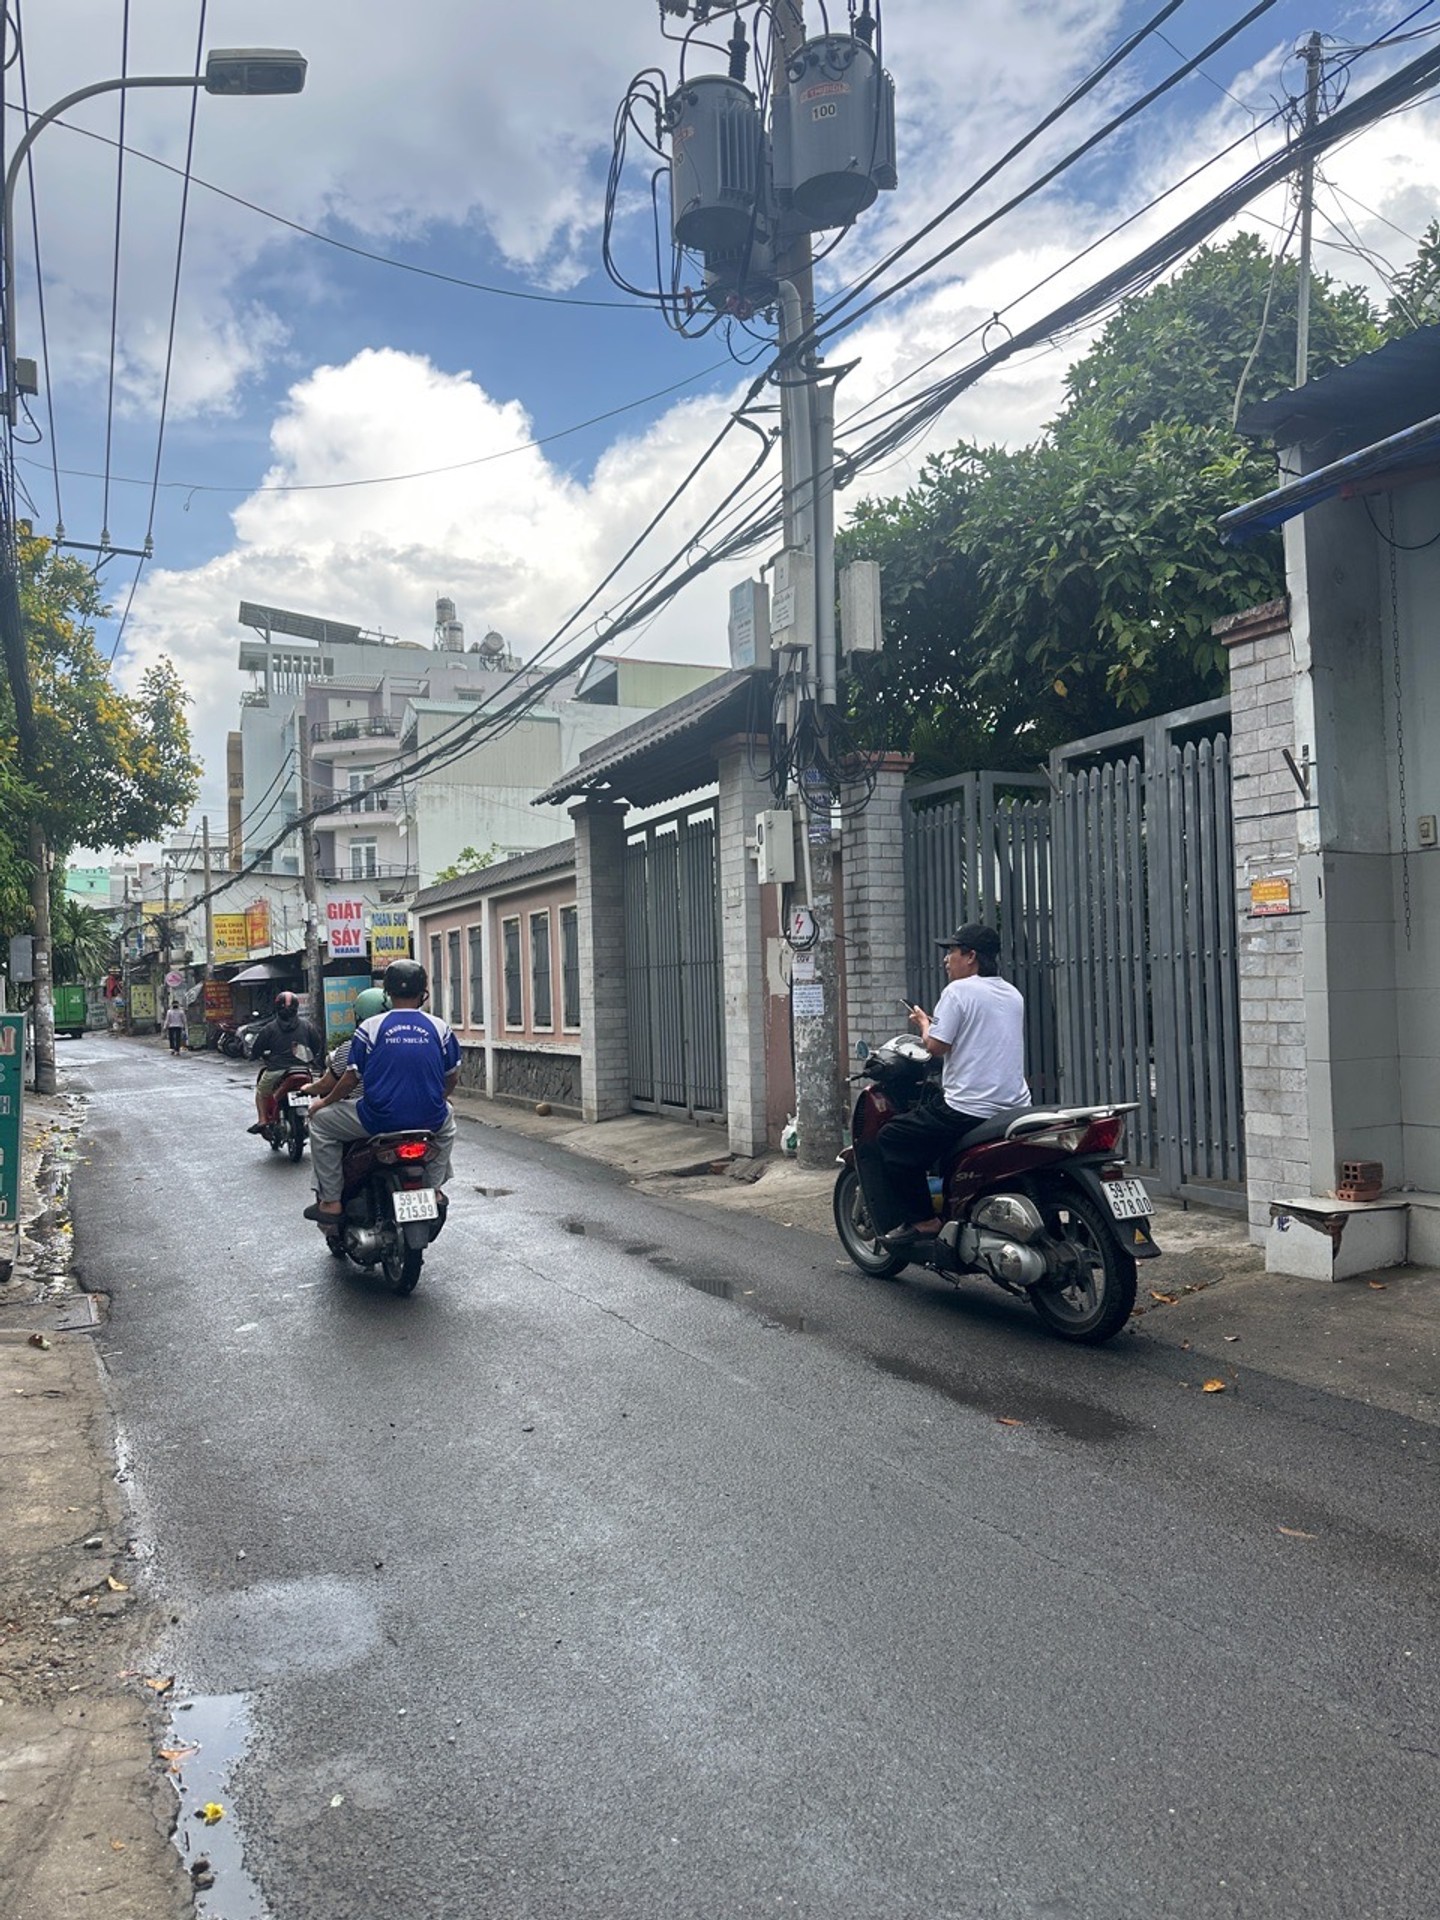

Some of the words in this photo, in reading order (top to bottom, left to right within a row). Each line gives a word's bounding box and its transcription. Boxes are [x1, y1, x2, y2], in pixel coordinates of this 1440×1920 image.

[813, 104, 835, 119] 100
[327, 900, 362, 922] GIẶT
[331, 923, 361, 946] SẤY
[1108, 1180, 1141, 1199] 59-F1
[397, 1204, 434, 1220] 215.99
[1113, 1197, 1152, 1217] 978.00
